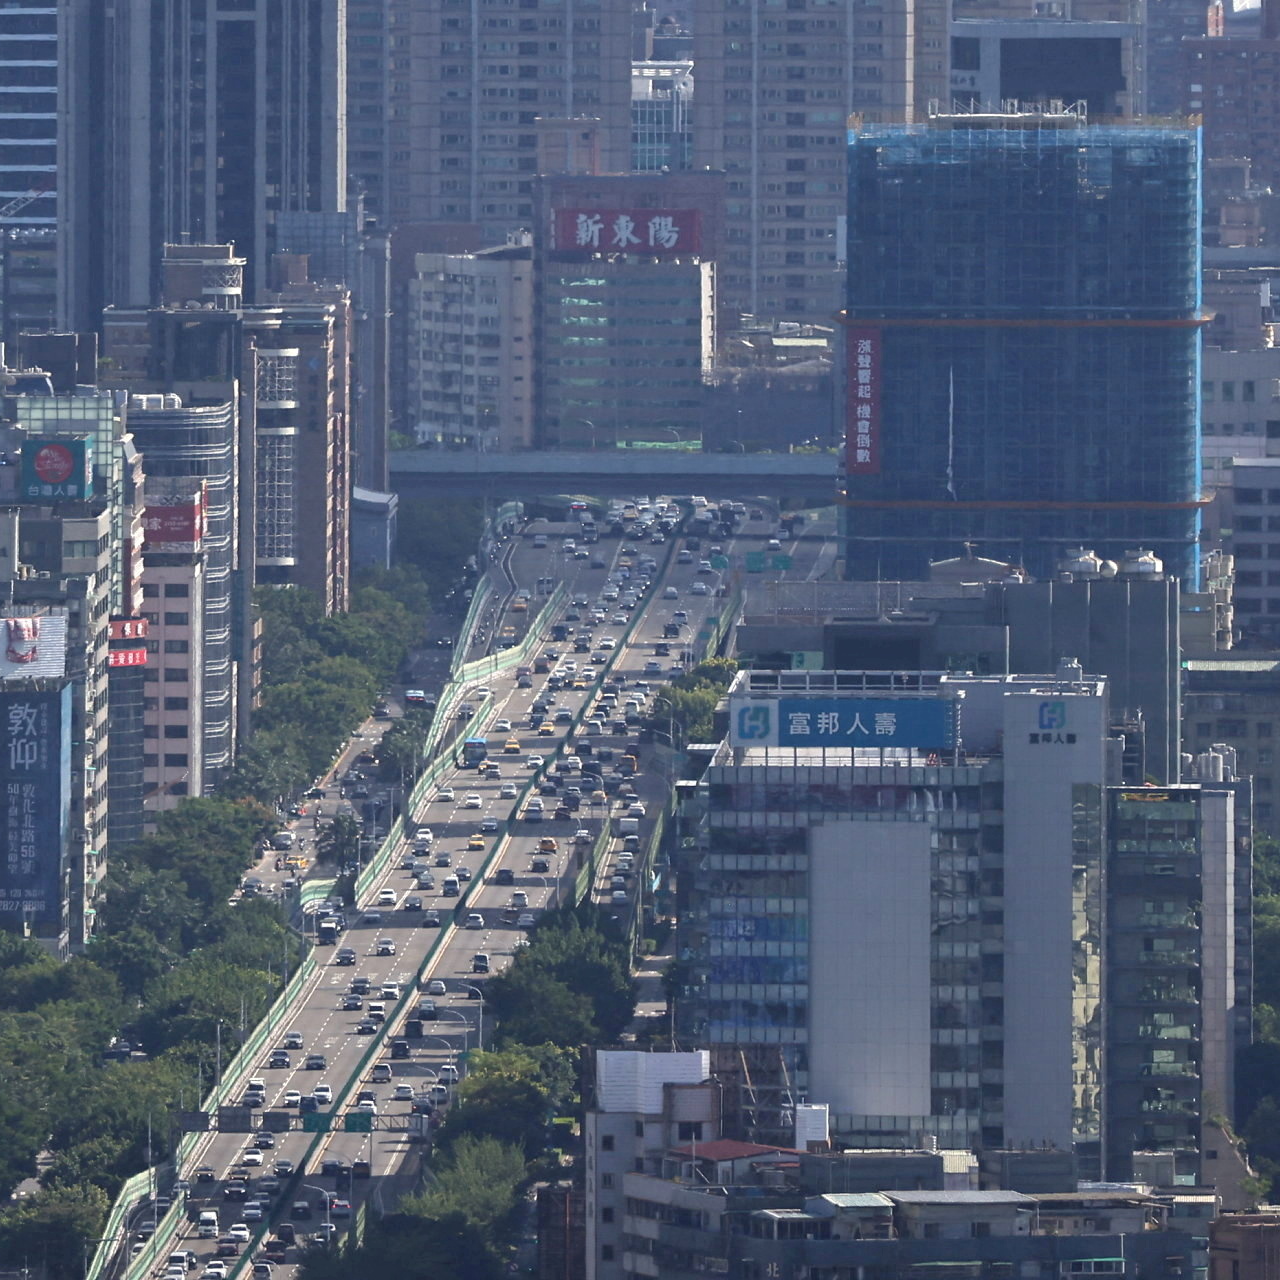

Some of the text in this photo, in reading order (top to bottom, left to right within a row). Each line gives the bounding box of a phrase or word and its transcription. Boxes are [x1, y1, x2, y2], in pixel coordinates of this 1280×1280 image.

[575, 213, 680, 248] 新東陽
[856, 404, 871, 463] 機會倒數
[8, 703, 38, 770] 敦仰
[788, 711, 897, 736] 富邦人壽
